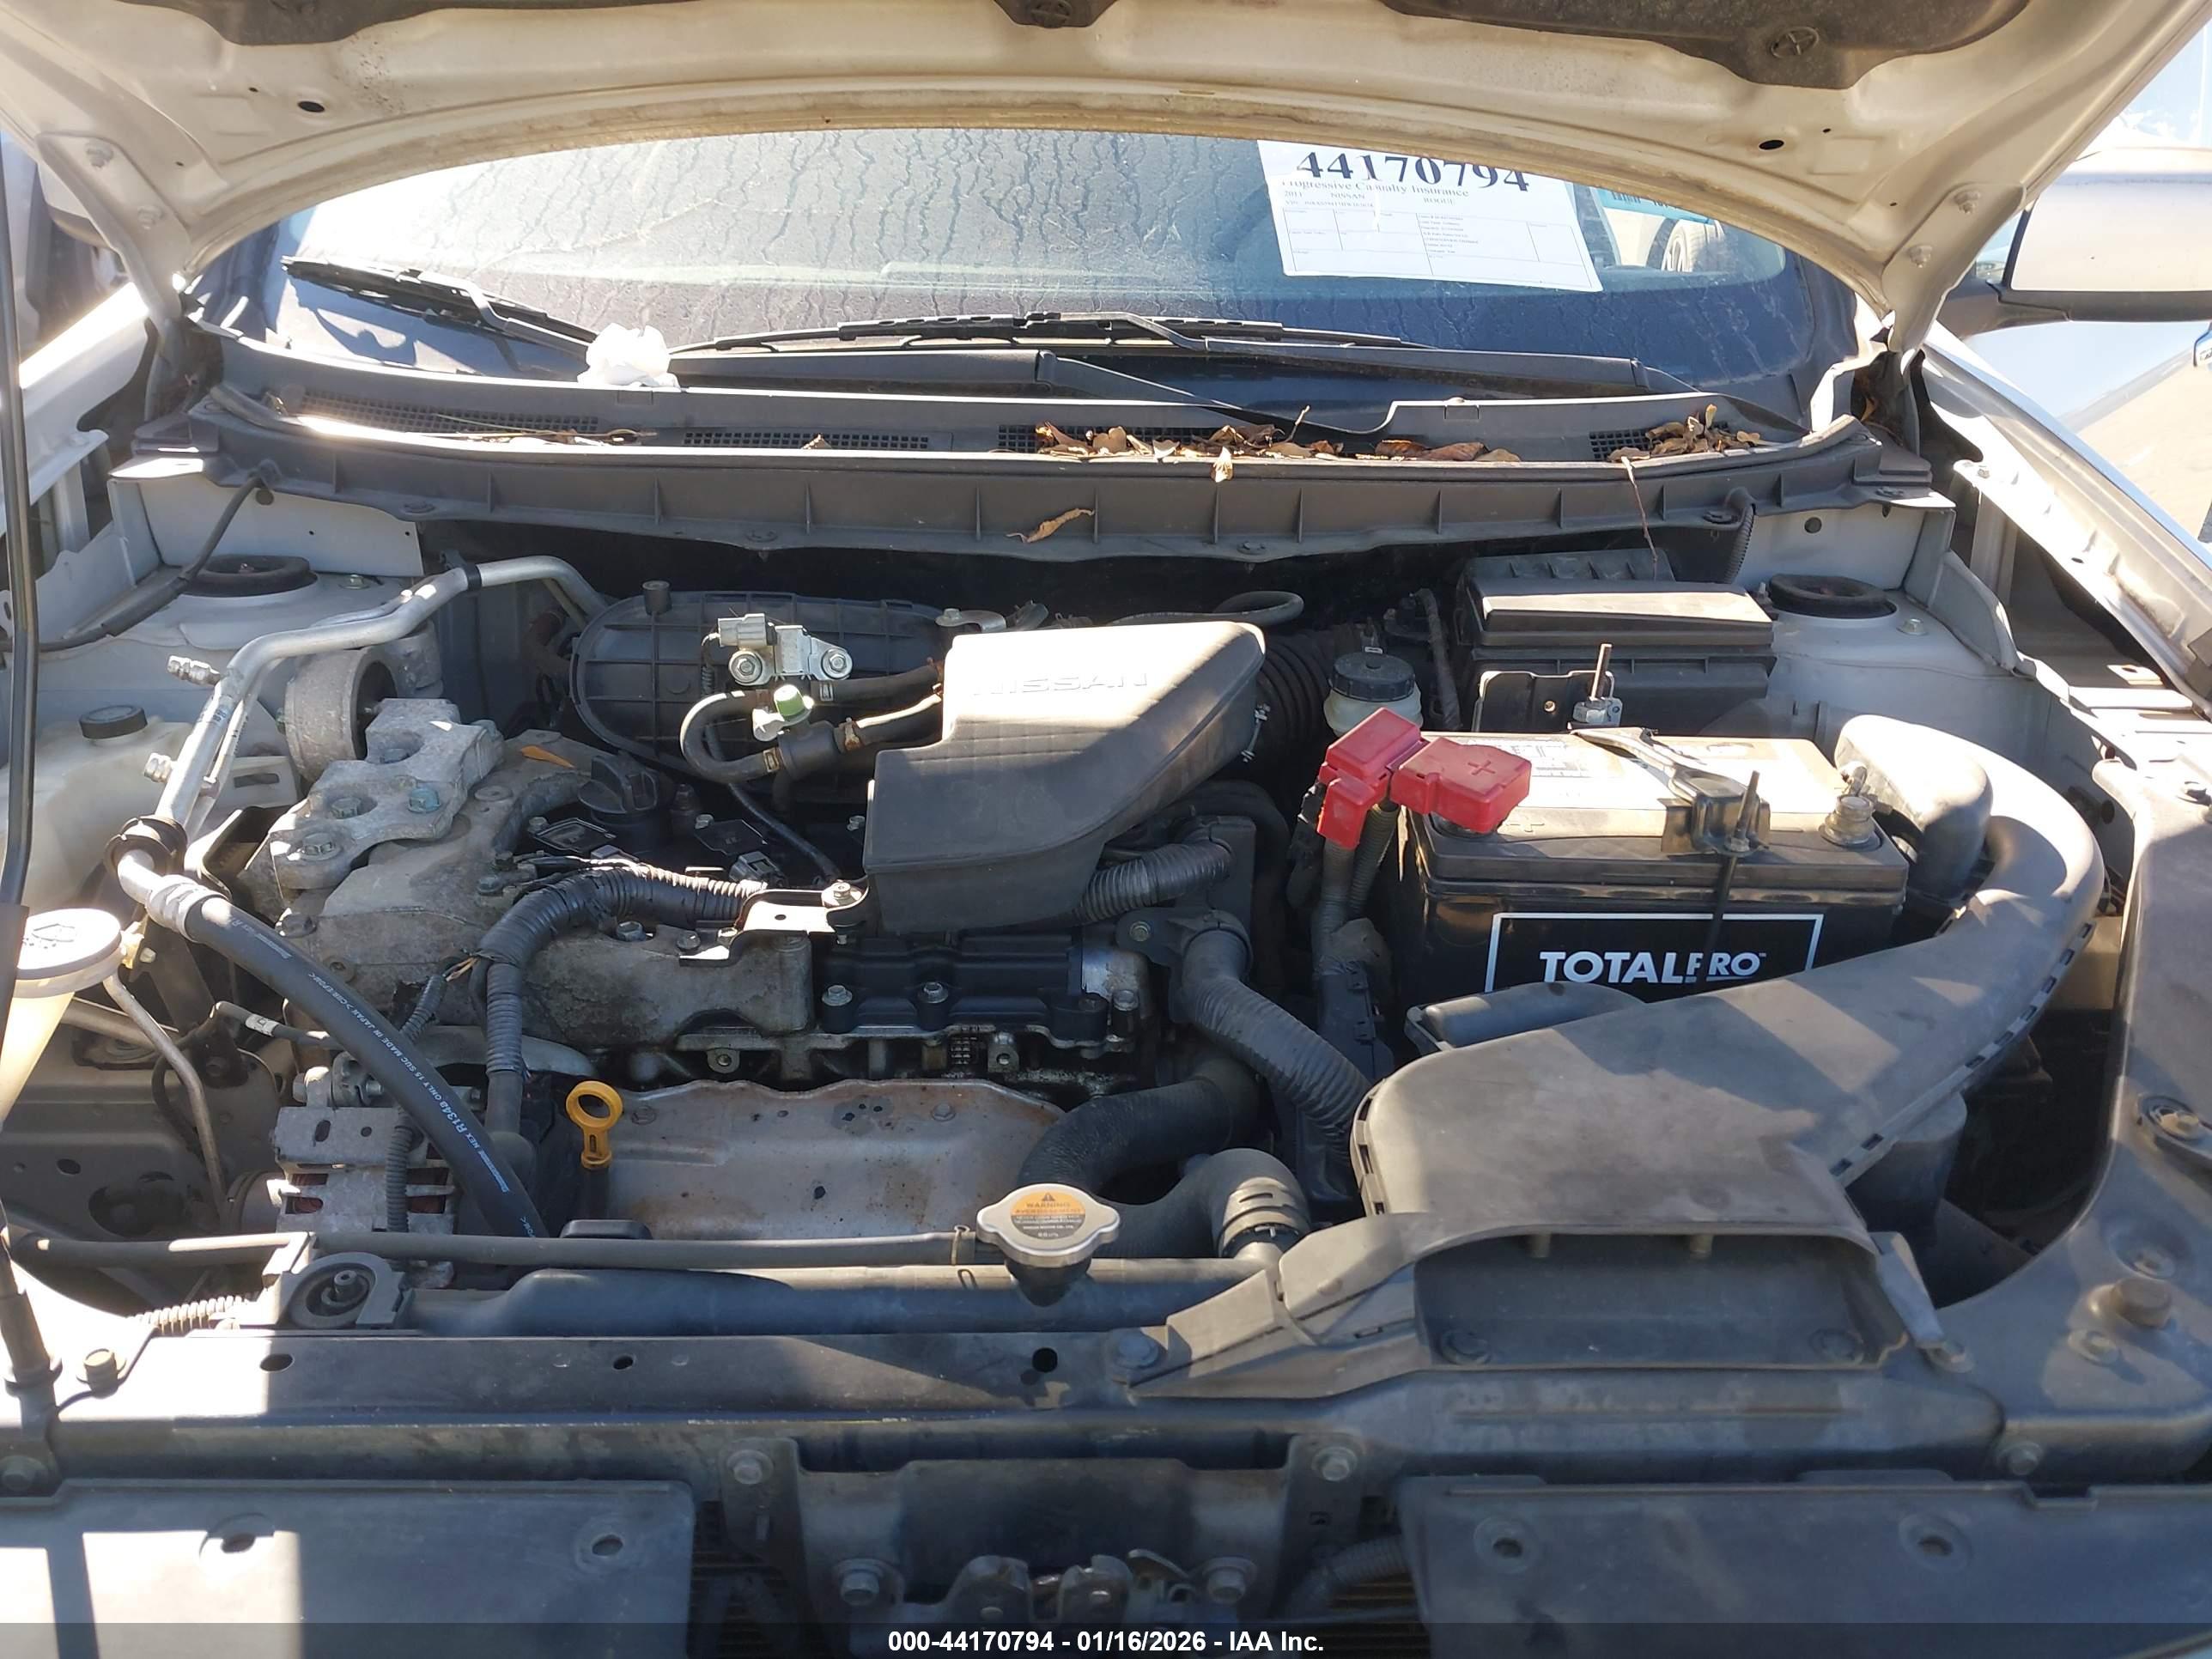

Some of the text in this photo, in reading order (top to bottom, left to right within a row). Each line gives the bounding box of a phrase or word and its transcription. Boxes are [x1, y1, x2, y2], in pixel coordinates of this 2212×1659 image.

[1297, 152, 1529, 191] 44170794
[1282, 179, 1469, 197] rogressive Caualty Insurance
[351, 1009, 376, 1029] JAPAN
[373, 1030, 384, 1038] IN
[382, 1037, 404, 1057] MADE
[423, 1082, 442, 1100] ONLY
[440, 1101, 468, 1133] R134a
